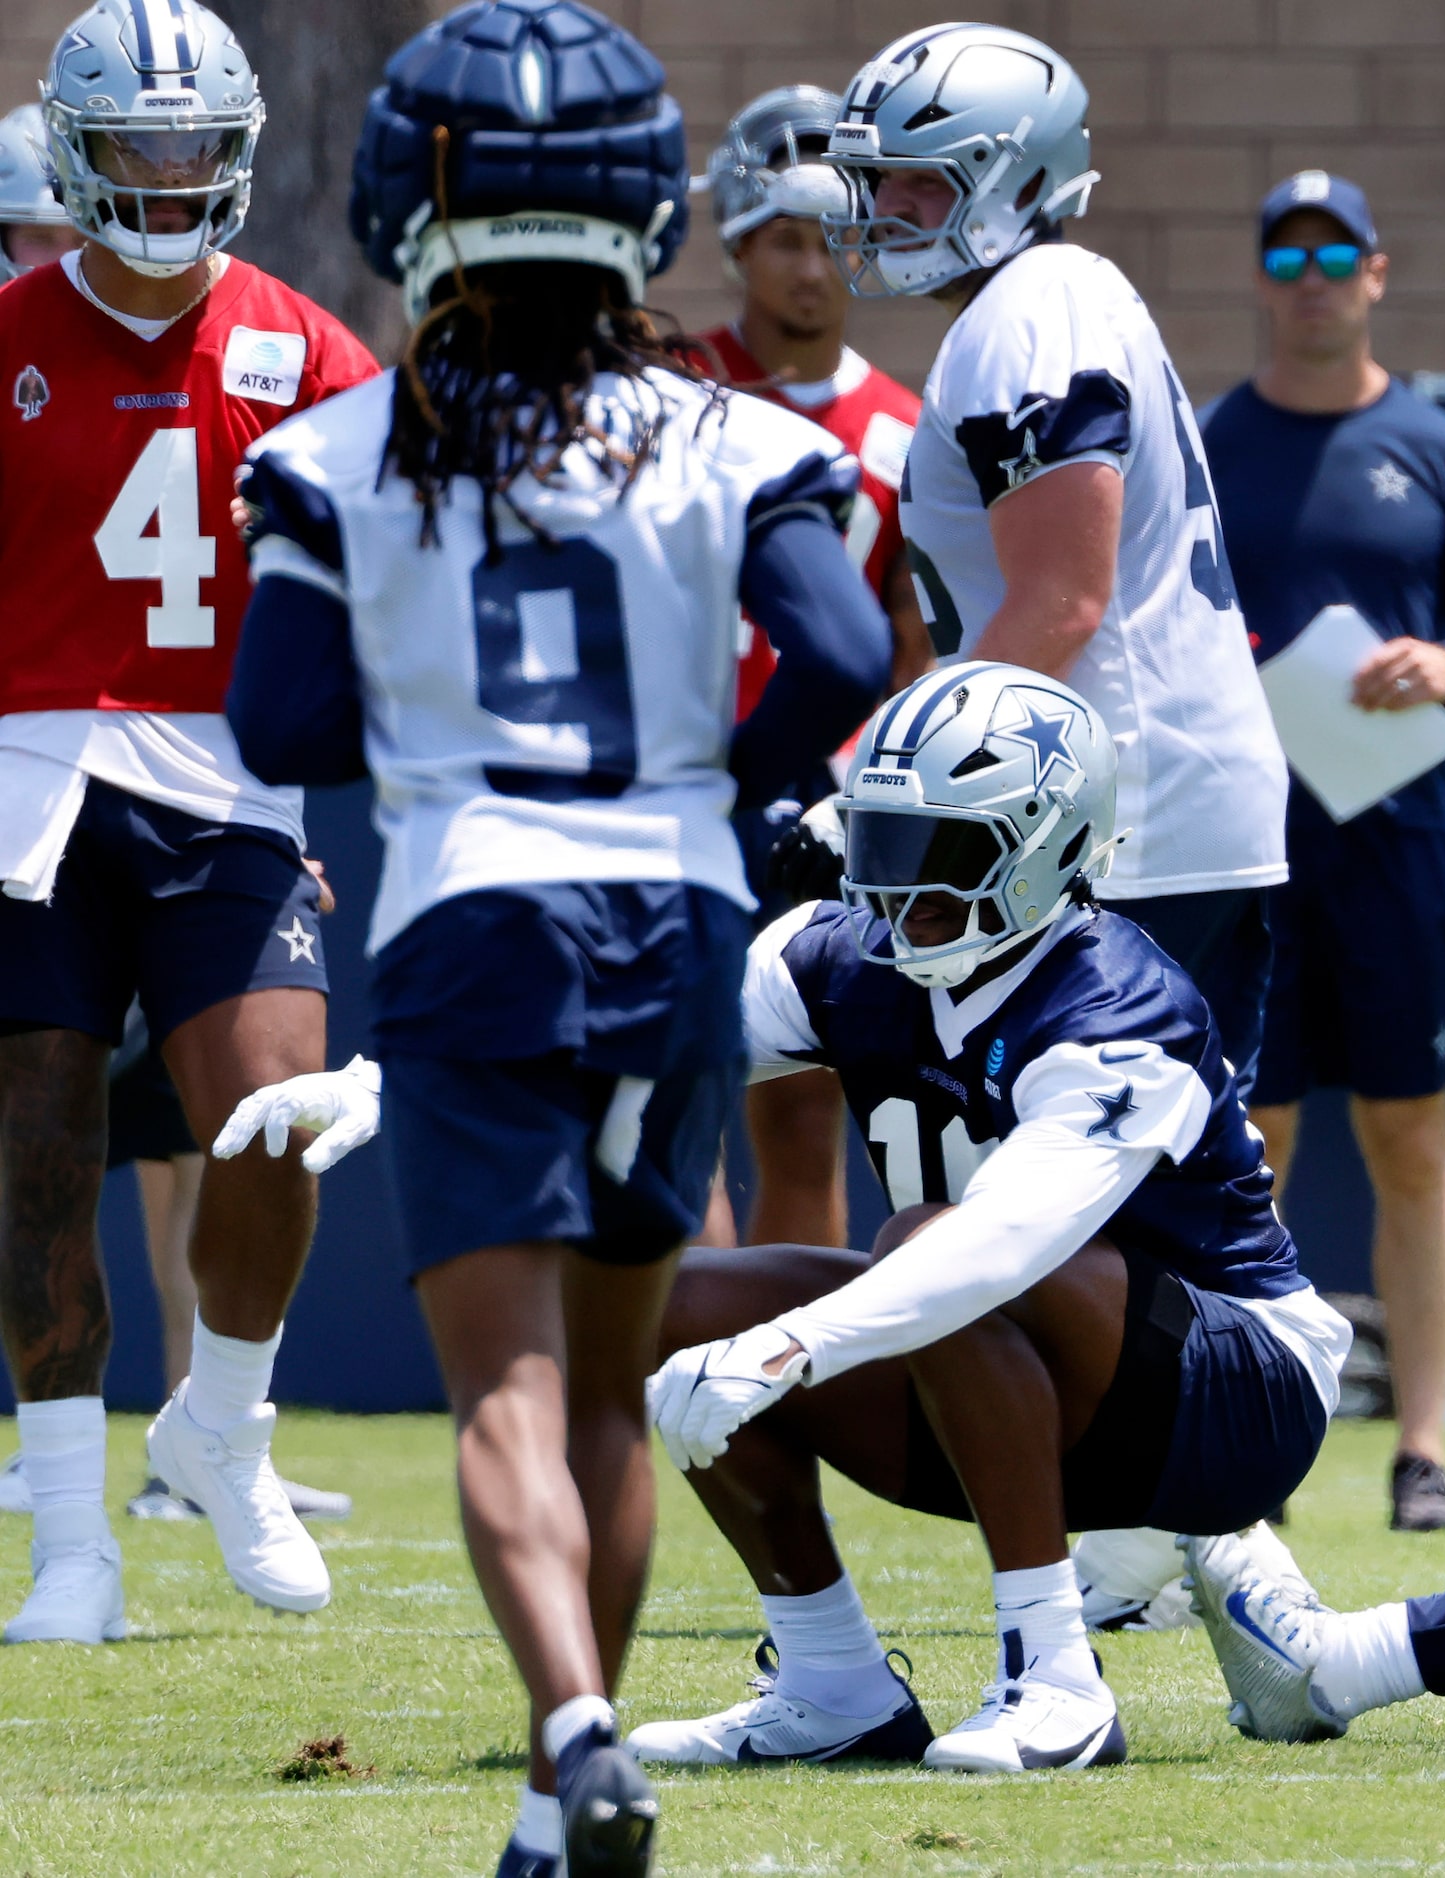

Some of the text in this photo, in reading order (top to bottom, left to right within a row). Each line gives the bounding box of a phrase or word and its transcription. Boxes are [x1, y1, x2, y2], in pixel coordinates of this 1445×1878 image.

[145, 97, 194, 107] COWBOYS
[238, 372, 283, 394] AT&T
[114, 392, 190, 410] COWBOYS
[92, 427, 217, 649] 4
[470, 534, 641, 802] 9
[862, 773, 907, 786] COWBOYS
